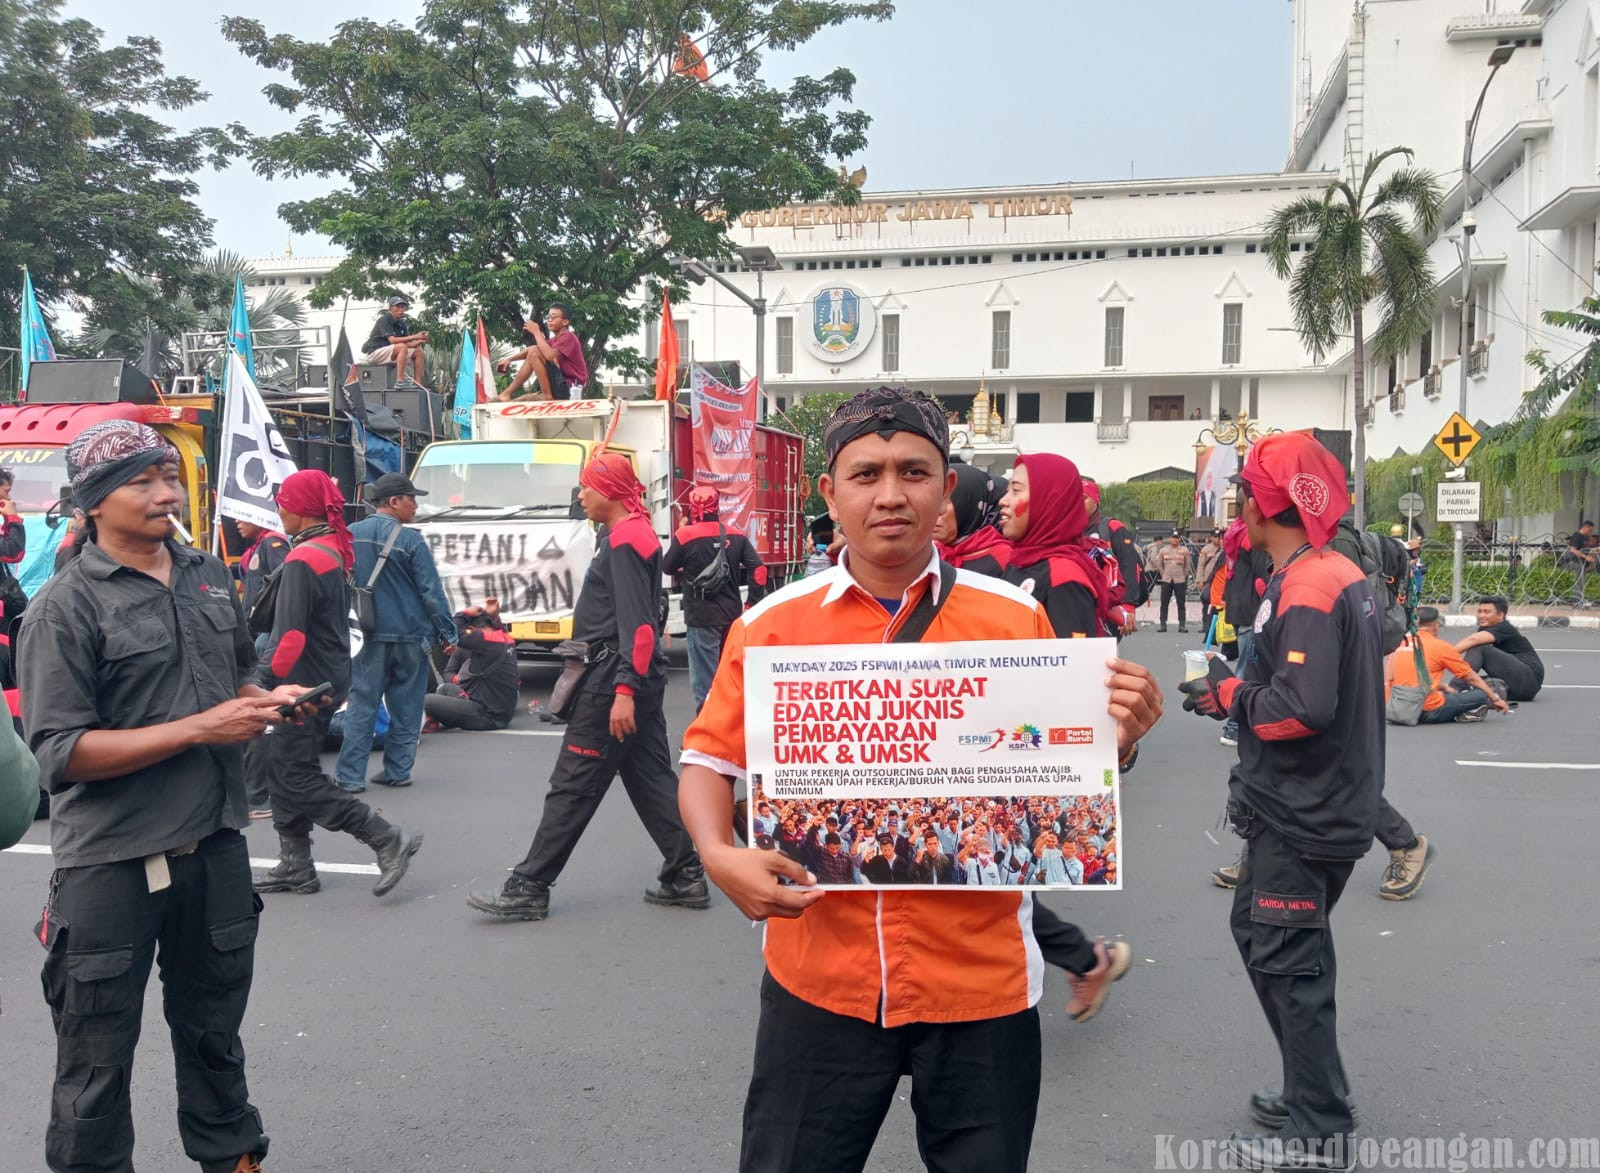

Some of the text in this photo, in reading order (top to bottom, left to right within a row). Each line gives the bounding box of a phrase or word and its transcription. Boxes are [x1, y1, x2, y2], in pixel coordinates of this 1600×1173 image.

[740, 202, 888, 228] GUBERNUR
[896, 199, 974, 221] JAWA
[984, 194, 1073, 218] TIMUR
[500, 400, 600, 416] OPTIMIS
[771, 655, 1067, 673] MAYDAY 2025 FSPMI JAWA TIMUR MENUNTUT
[773, 677, 987, 701] TERBITKAN SURAT
[773, 699, 964, 722] EDARAN JUKNIS
[773, 721, 937, 743] PEMBAYARAN
[958, 735, 992, 744] FSPMI
[774, 743, 931, 764] UMK & UMSK
[775, 765, 1071, 779] UNTUK PEKERJA OUTSOURCING DAN BAGI PENGUSAHA WAJIB
[775, 774, 1081, 787] MENAIKKAN UPAH PEKERJA/BURUH YANG SUDAH DIATAS UPAH
[775, 786, 823, 795] MINIMUM
[1258, 898, 1317, 910] GARDA METAL
